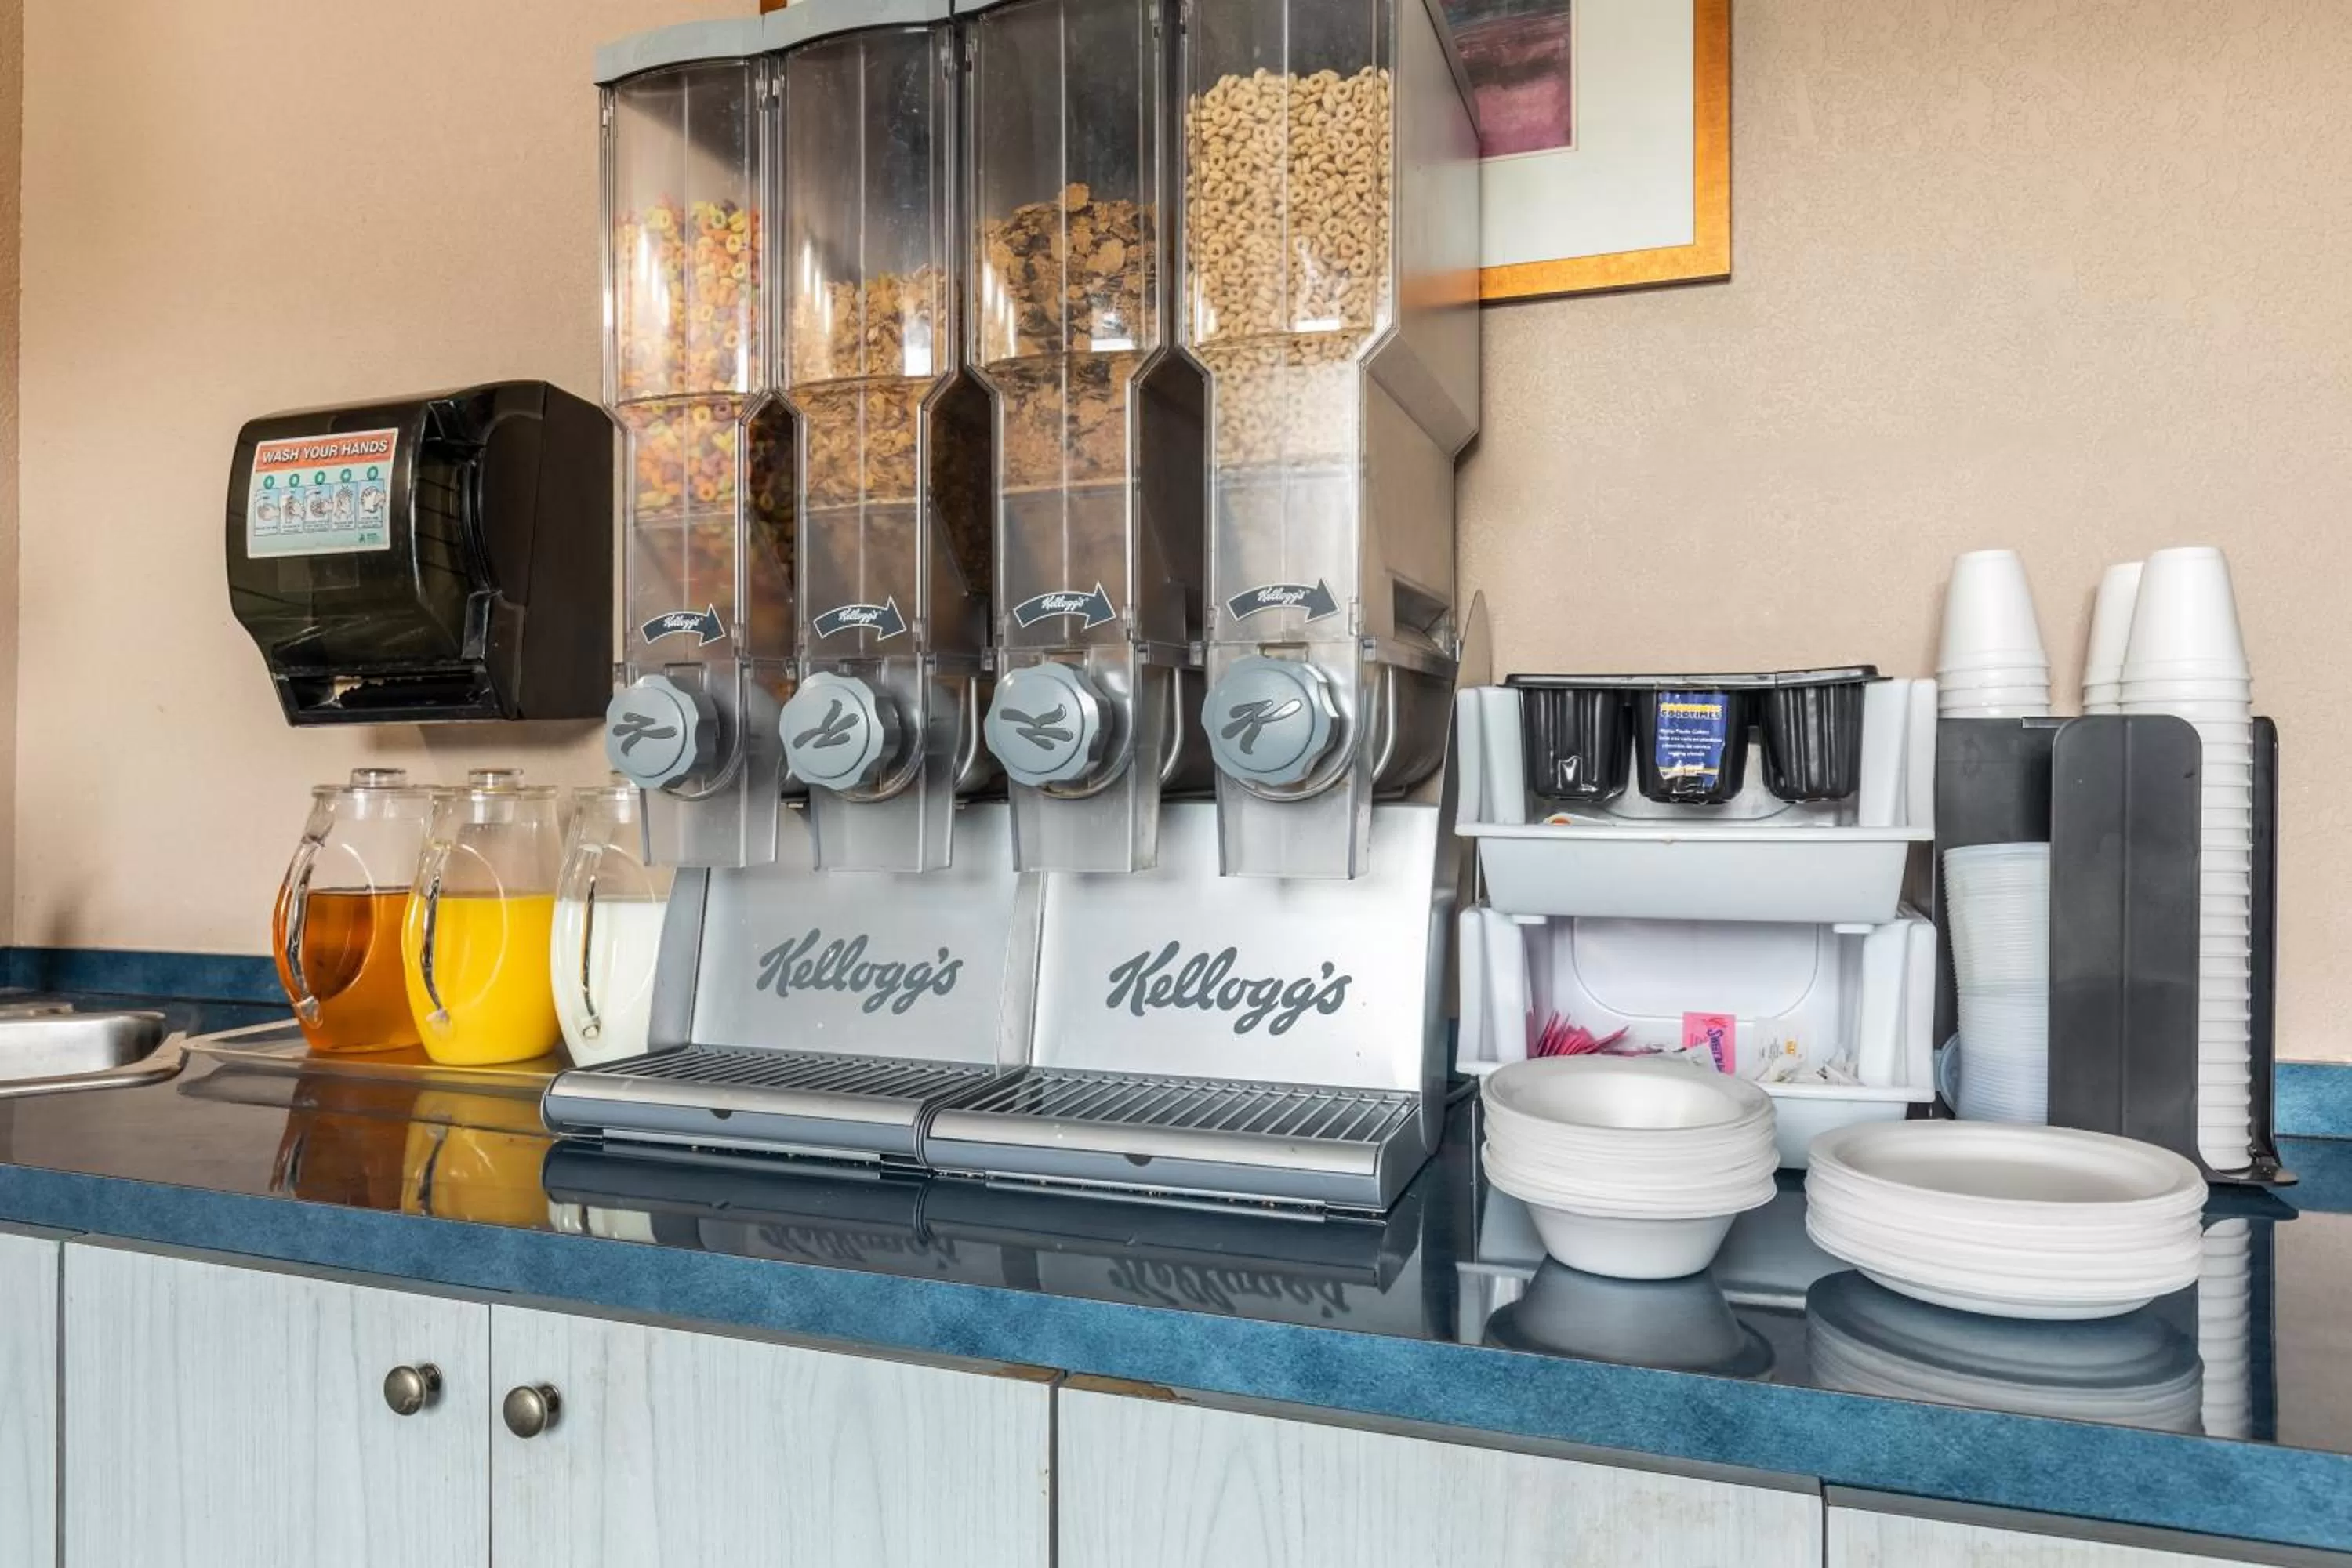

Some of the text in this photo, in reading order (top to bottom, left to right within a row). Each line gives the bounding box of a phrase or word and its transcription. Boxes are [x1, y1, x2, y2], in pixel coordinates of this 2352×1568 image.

[263, 439, 387, 463] WASH YOUR HANDS
[1040, 595, 1085, 612] Kellogg's
[1257, 586, 1306, 605] Kellogg's
[756, 928, 964, 1014] Kellogg's
[1106, 941, 1352, 1036] Kellogg's
